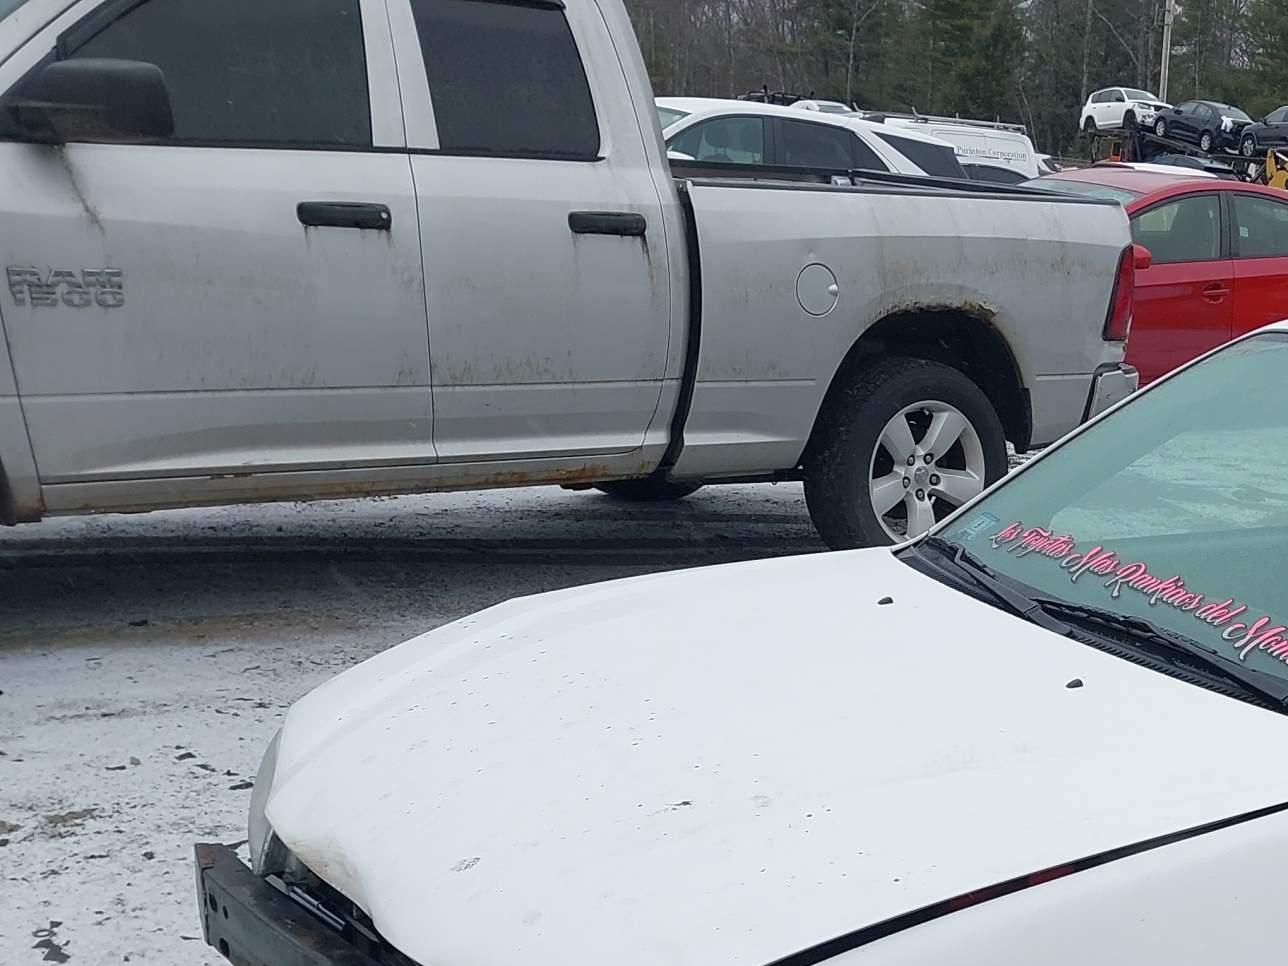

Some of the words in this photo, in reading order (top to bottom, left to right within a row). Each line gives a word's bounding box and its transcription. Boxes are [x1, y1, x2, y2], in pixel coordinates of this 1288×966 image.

[988, 147, 1027, 160] Corporation
[6, 265, 123, 289] RAM
[11, 287, 125, 308] 1500
[1195, 598, 1248, 627] del
